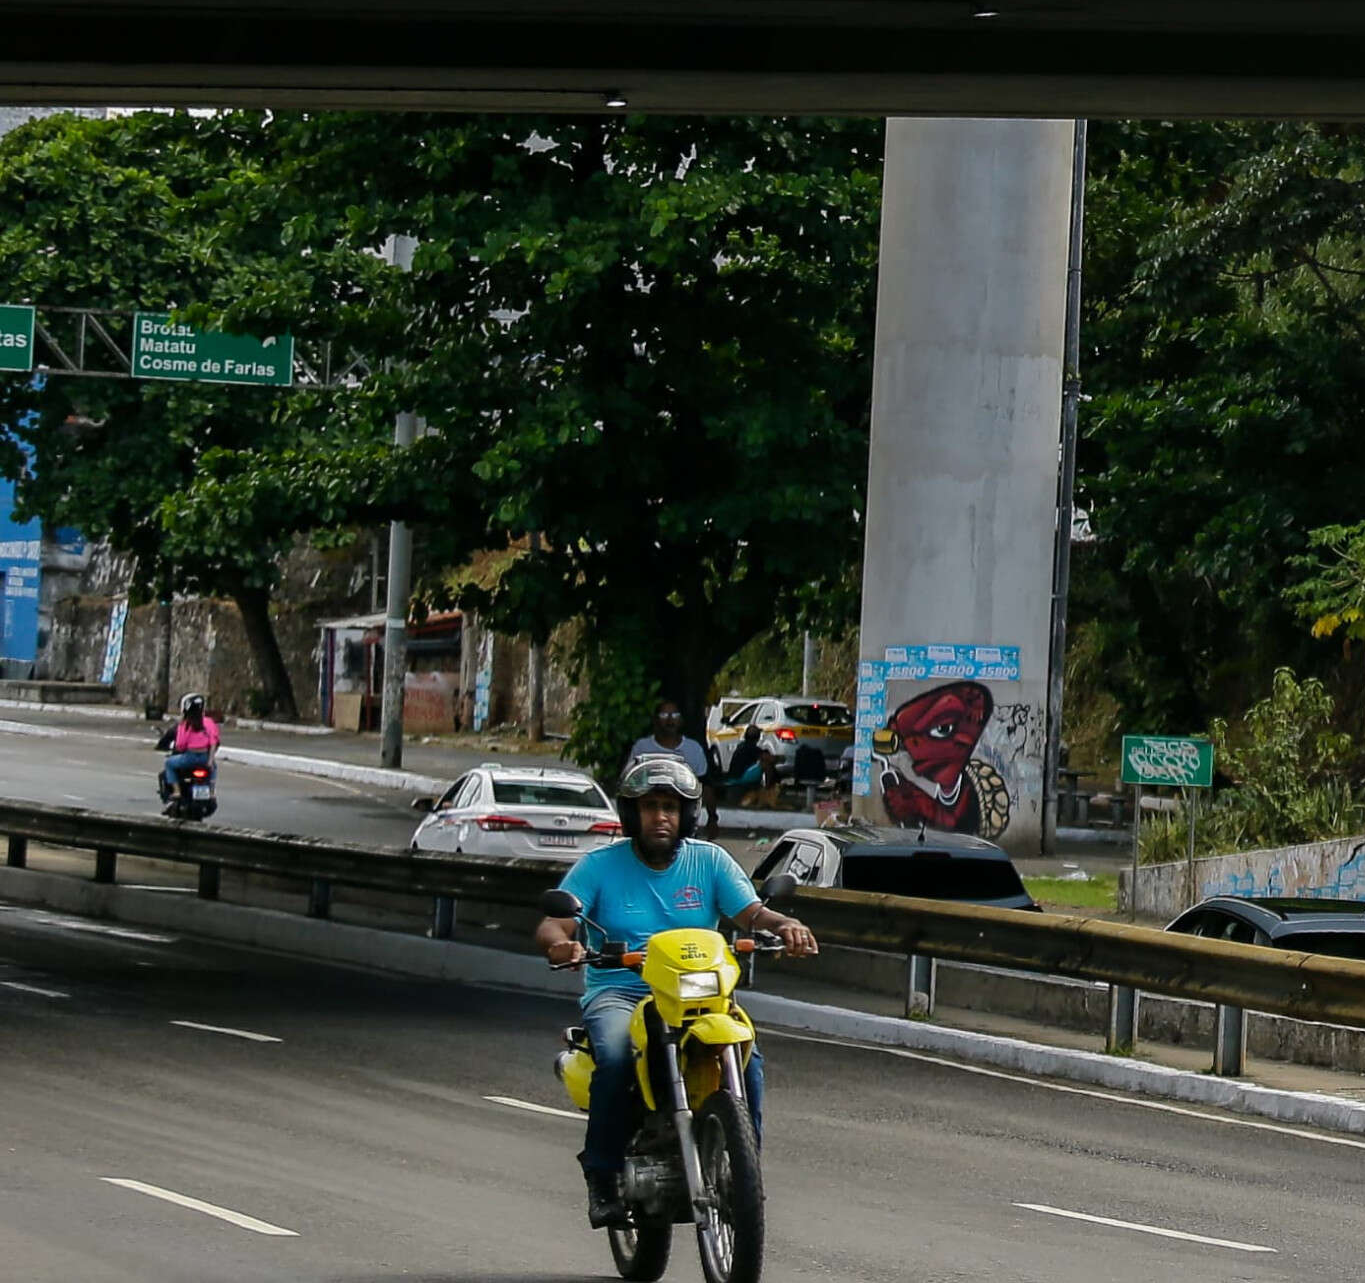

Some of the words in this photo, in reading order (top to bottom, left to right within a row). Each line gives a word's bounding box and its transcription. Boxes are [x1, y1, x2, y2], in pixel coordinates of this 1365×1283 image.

[140, 337, 196, 355] Matatu
[140, 354, 197, 373] Cosme
[201, 357, 221, 374] de
[225, 360, 276, 377] Farias
[888, 664, 926, 678] 45800
[931, 663, 975, 677] 45800
[979, 665, 1018, 678] 45800
